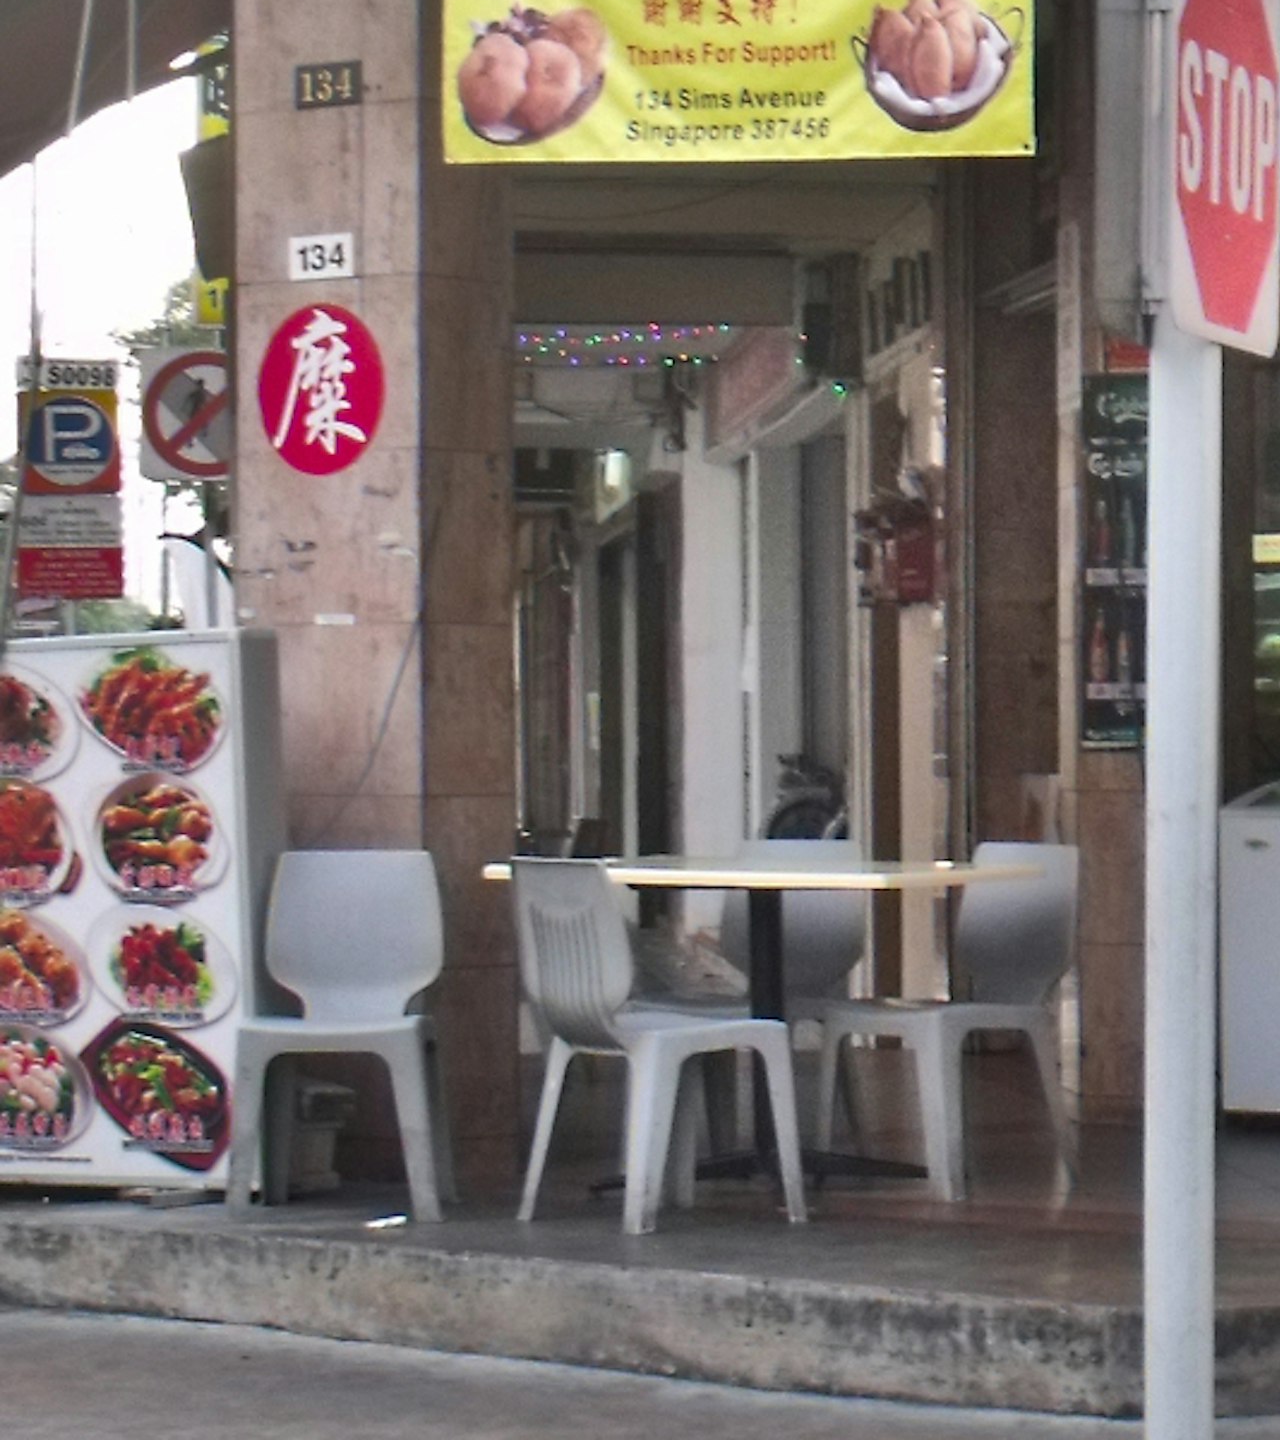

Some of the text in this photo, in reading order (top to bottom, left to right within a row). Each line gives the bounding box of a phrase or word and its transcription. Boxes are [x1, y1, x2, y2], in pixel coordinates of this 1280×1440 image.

[626, 40, 837, 67] Thanks For Support!
[299, 68, 353, 103] 134
[635, 87, 827, 110] 134 Sims Avenue
[626, 117, 831, 147] Singapore 387456
[1179, 38, 1277, 223] STOP
[297, 243, 344, 271] 134
